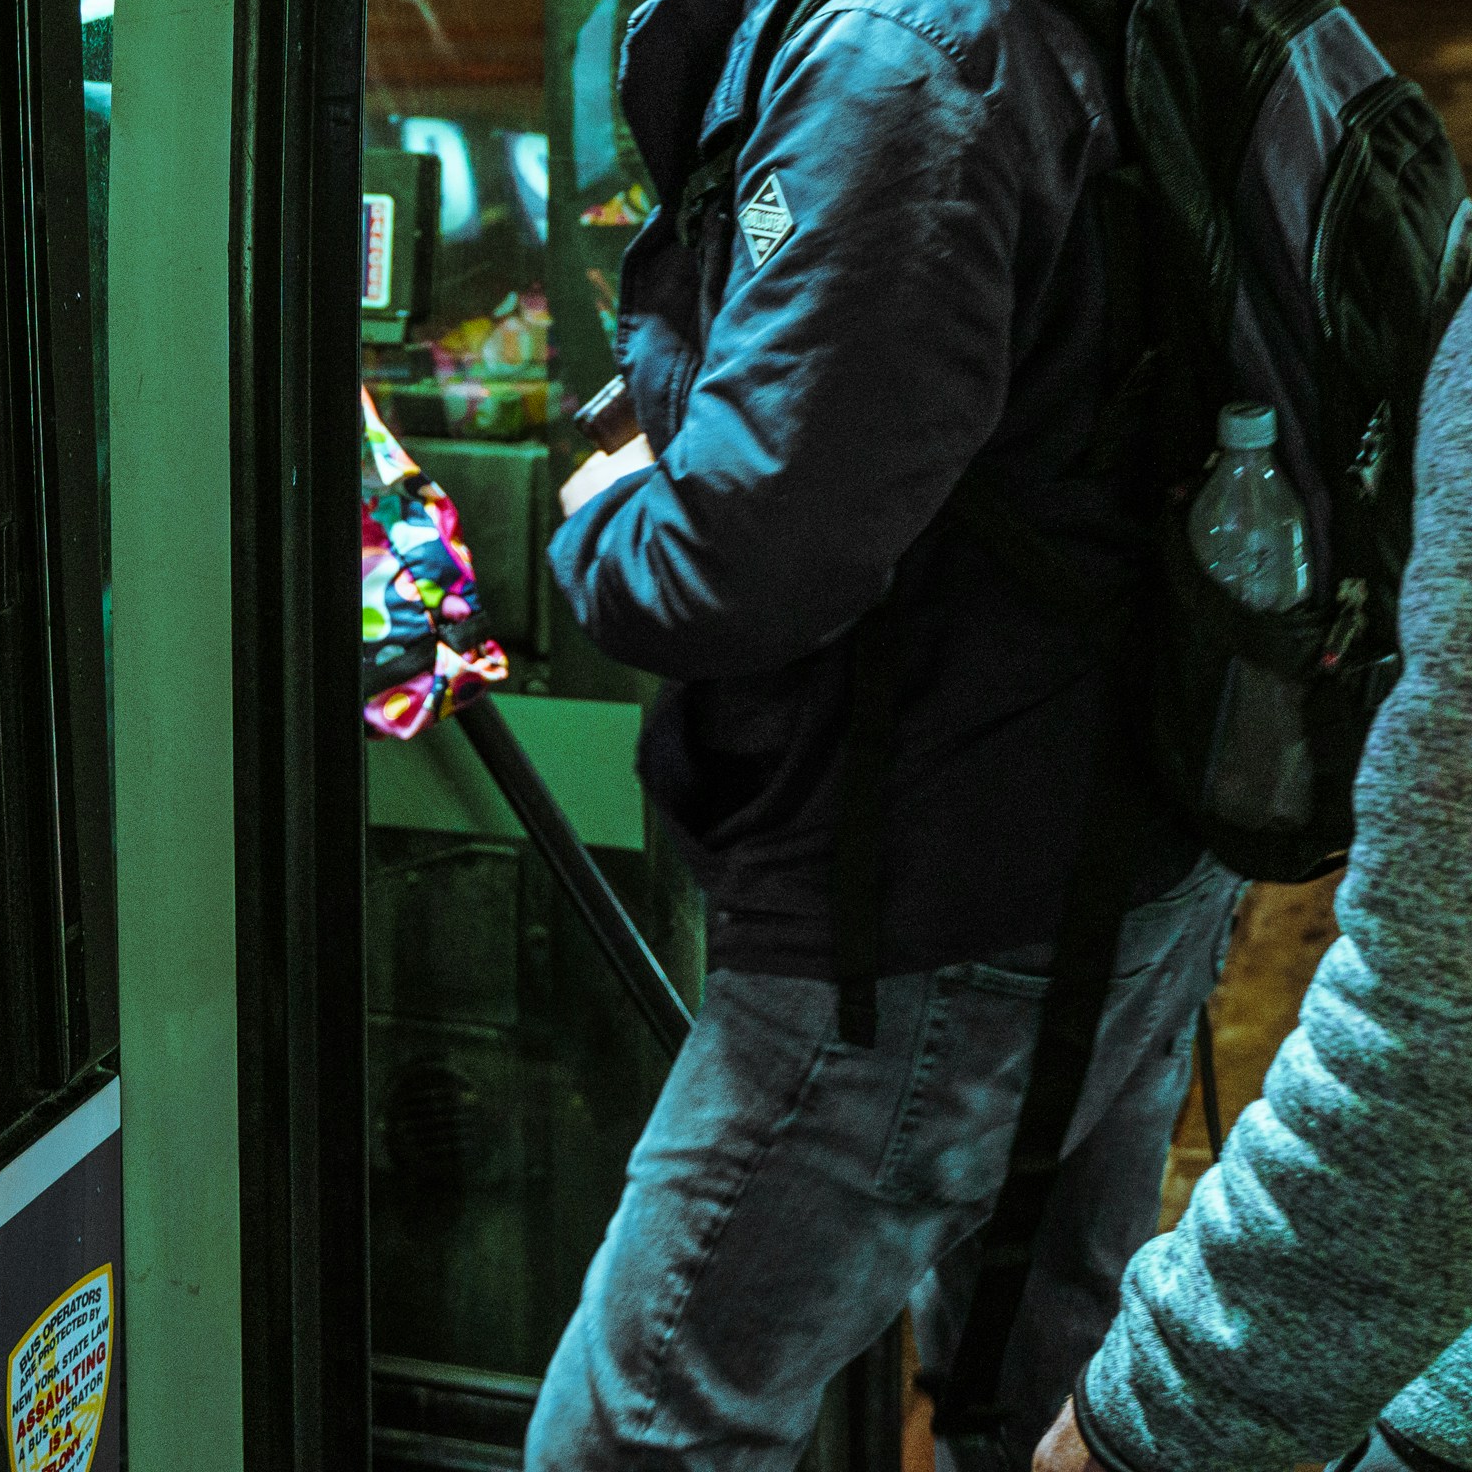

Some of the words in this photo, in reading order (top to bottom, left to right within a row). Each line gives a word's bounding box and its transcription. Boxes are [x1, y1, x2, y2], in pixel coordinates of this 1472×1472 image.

[12, 1386, 33, 1418] NEW
[35, 1361, 60, 1394] YORK
[62, 1334, 89, 1370] STATE
[91, 1314, 110, 1343] LAW
[19, 1335, 42, 1374] BUS
[42, 1286, 102, 1340] OPERATORS
[20, 1359, 38, 1392] ARE
[38, 1312, 88, 1366] PROTECTED
[89, 1306, 102, 1322] BY
[16, 1341, 106, 1445] ASSAULTING
[18, 1447, 26, 1465] A
[29, 1423, 49, 1454] BUS
[51, 1371, 103, 1429] OPERATOR
[49, 1430, 61, 1457] IS
[63, 1420, 73, 1443] A
